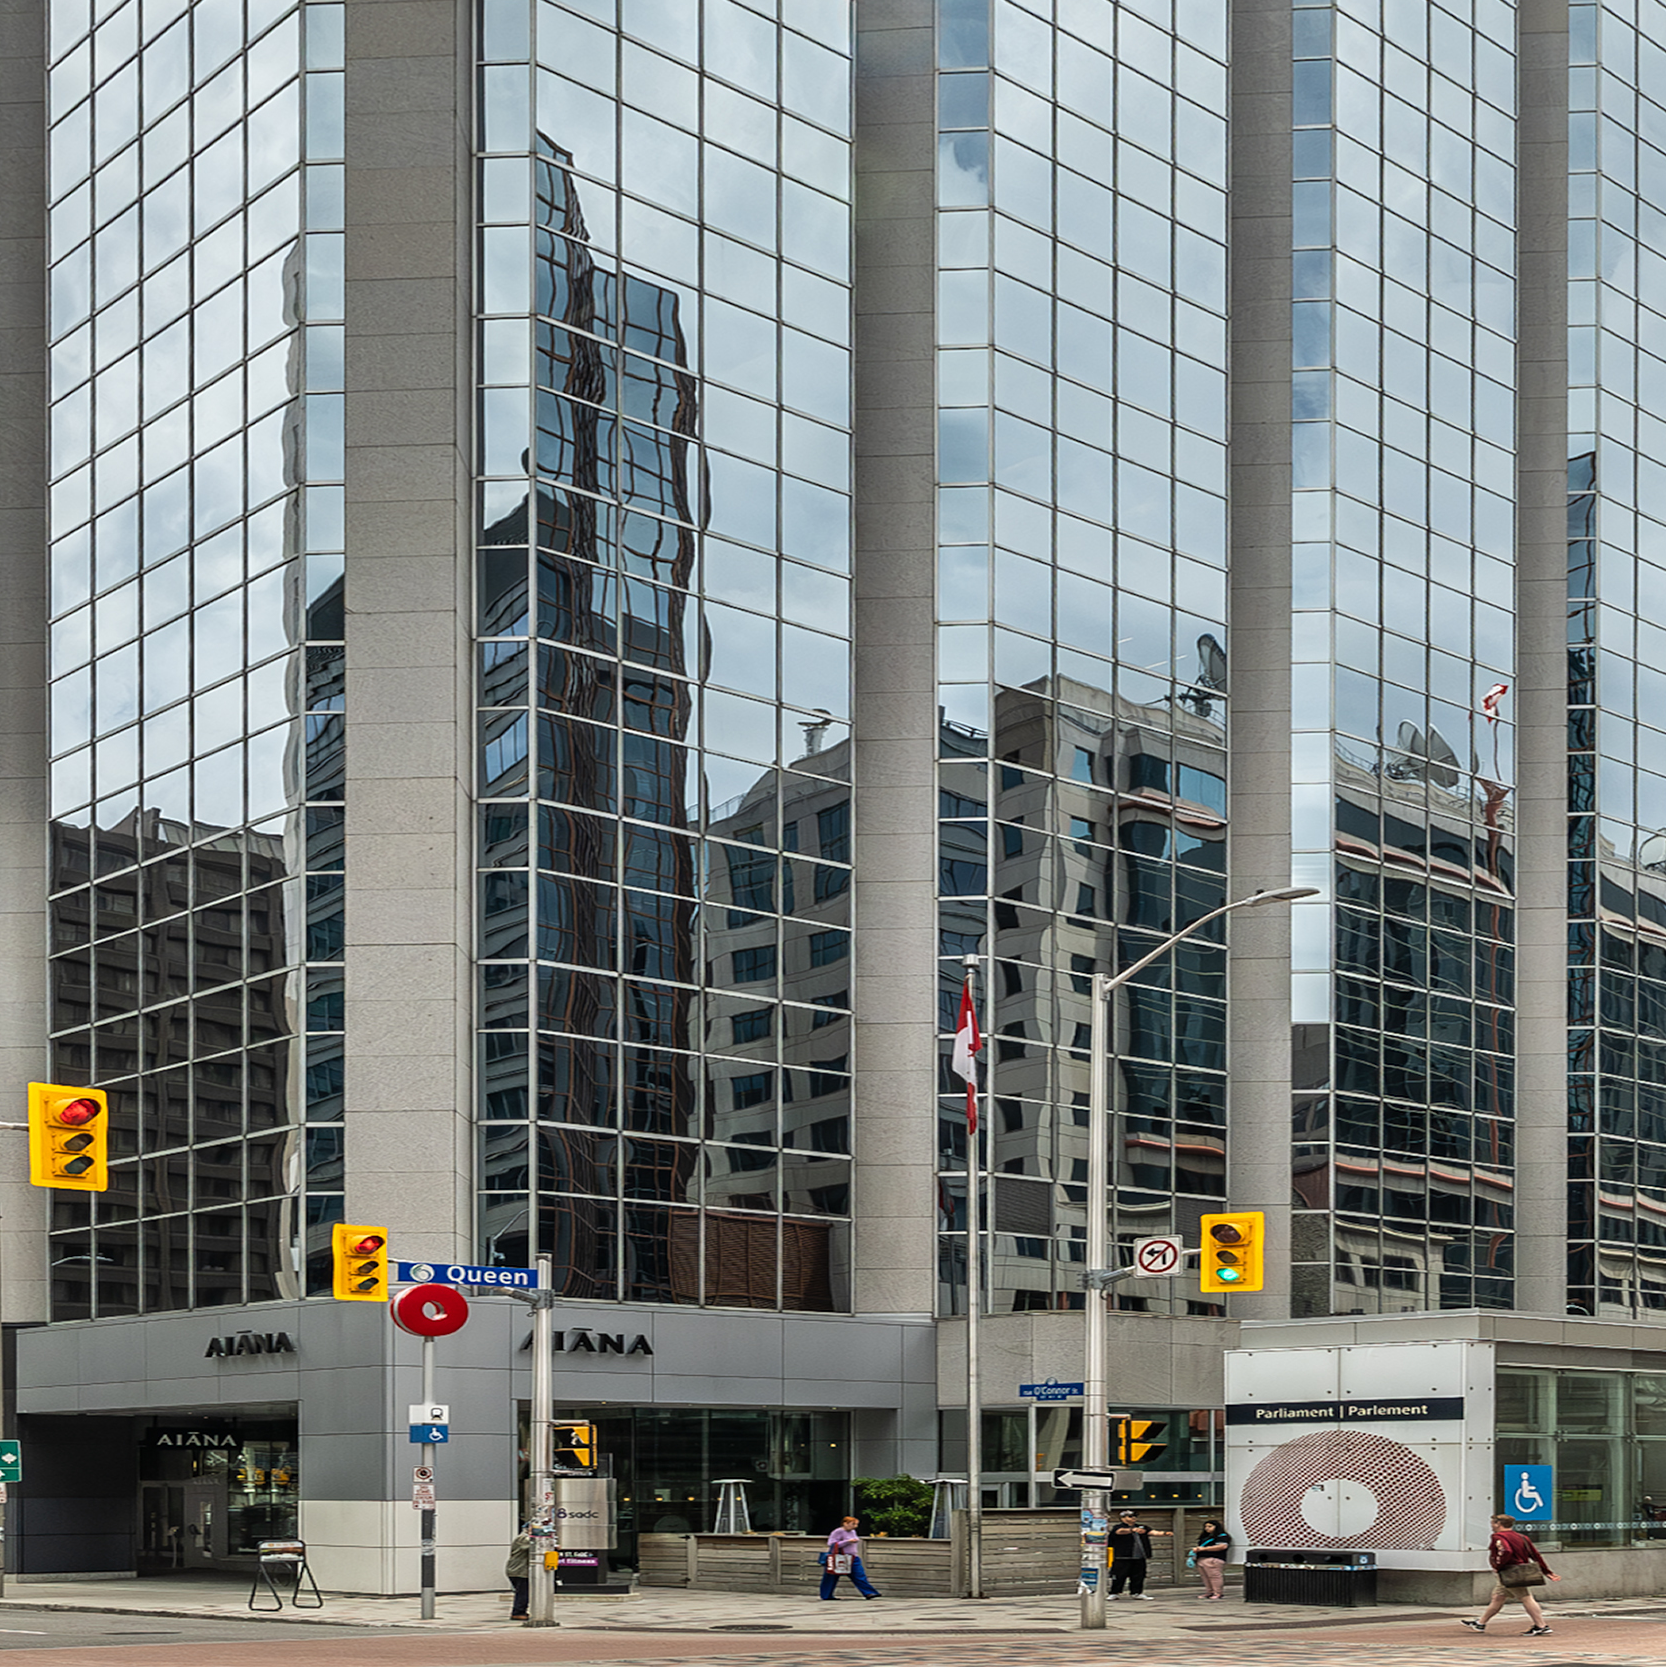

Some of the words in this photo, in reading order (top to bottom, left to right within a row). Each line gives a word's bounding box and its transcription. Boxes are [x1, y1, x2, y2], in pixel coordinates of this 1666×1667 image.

[447, 1266, 528, 1285] Queen
[204, 1330, 297, 1358] AIĀNA
[1255, 1406, 1335, 1419] Parliament
[1347, 1405, 1429, 1417] Parlement
[156, 1431, 237, 1447] AIĀNA
